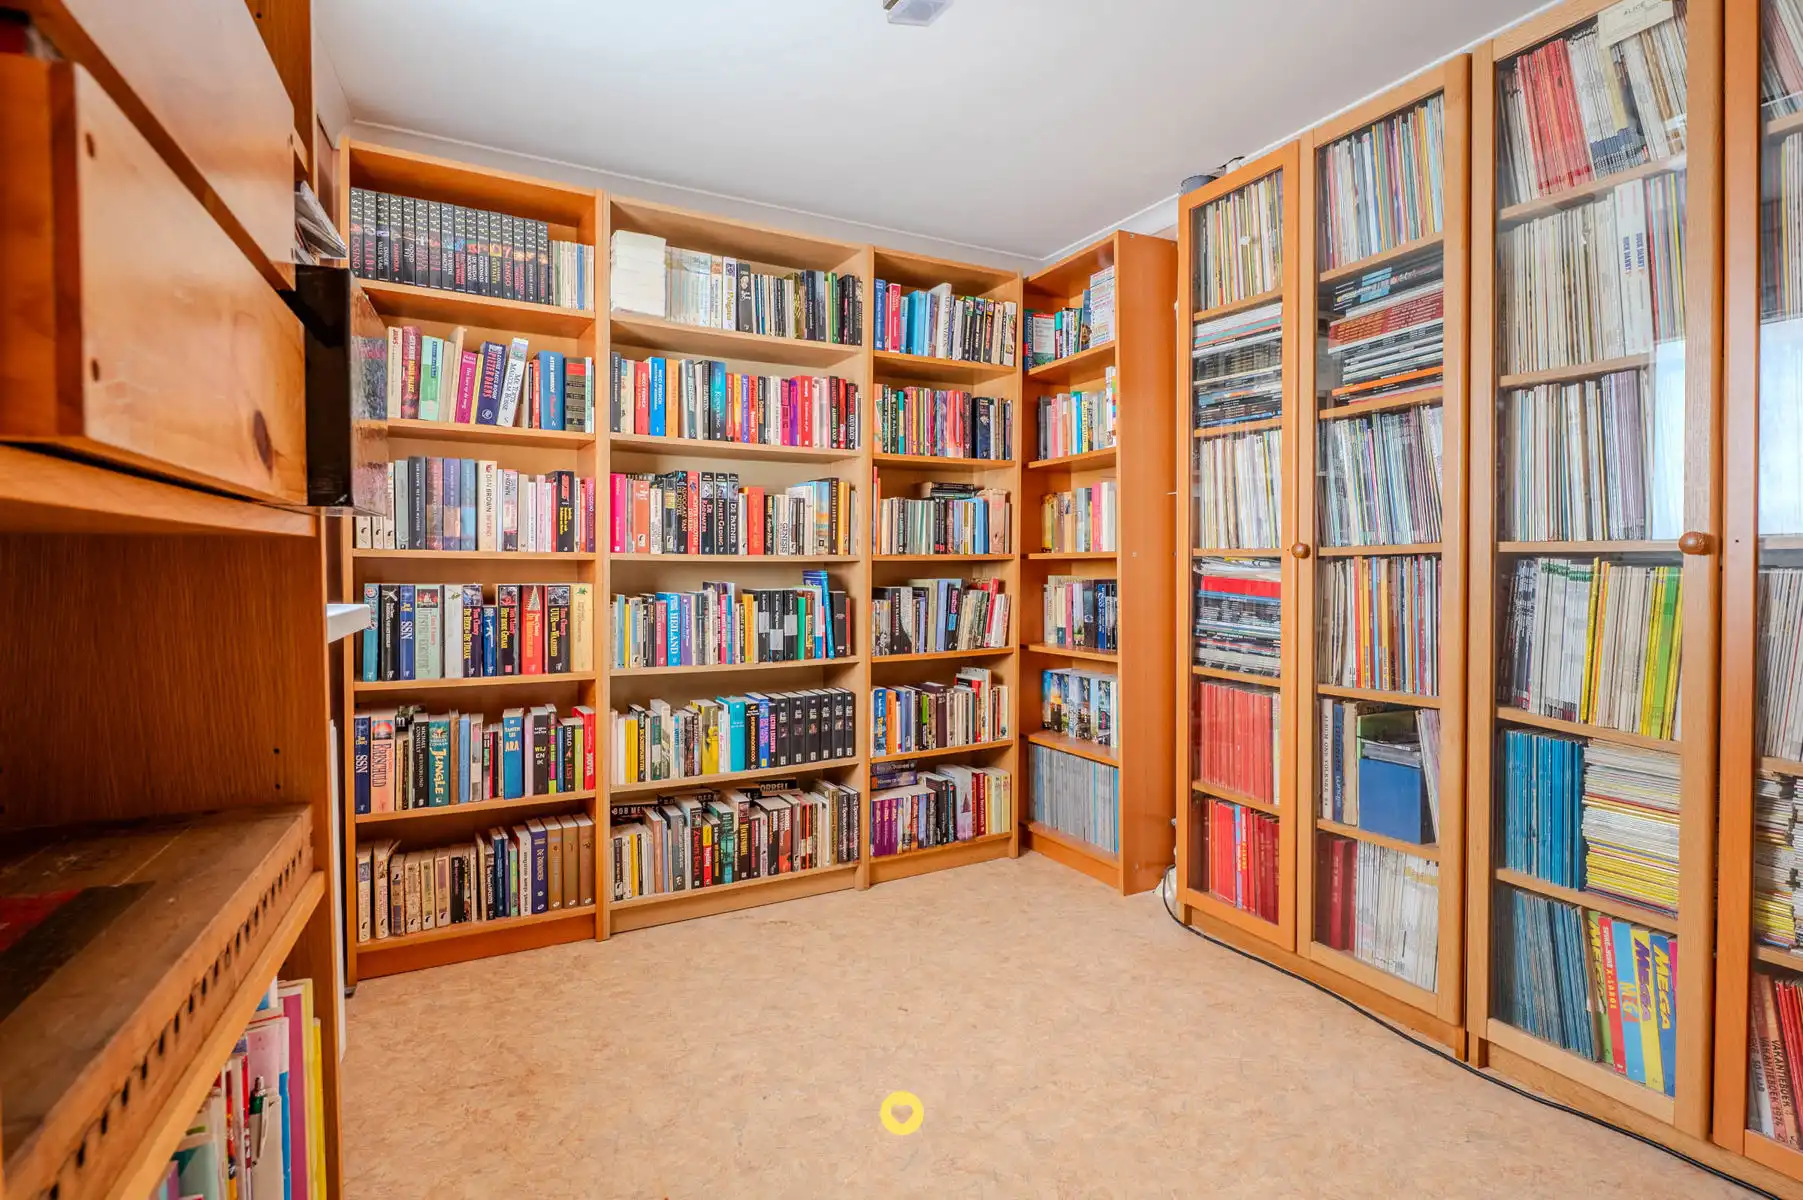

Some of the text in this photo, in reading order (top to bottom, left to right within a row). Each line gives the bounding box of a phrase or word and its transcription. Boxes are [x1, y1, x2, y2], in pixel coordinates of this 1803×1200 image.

[352, 237, 360, 268] CASINO
[364, 240, 374, 270] ALIBI
[483, 352, 497, 398] PIETER DAENS
[707, 505, 712, 513] DE
[718, 500, 724, 508] IN
[730, 503, 736, 514] DE
[401, 621, 412, 639] SSN
[472, 608, 480, 635] Tom Clancy
[550, 608, 559, 622] UUR
[559, 619, 567, 636] Clancy
[670, 612, 678, 654] HEILAND
[356, 755, 368, 773] SSN
[372, 743, 392, 787] ERESCHULD
[429, 747, 446, 794] JUNGLE
[613, 807, 628, 815] BOB
[1634, 938, 1651, 1021] MEGA
[1654, 944, 1672, 1030] MEGA
[1619, 981, 1639, 1022] MEGA
[1760, 1036, 1779, 1102] VAKANTIEBOEK
[1771, 1040, 1790, 1106] VAKANTIEBOEK
